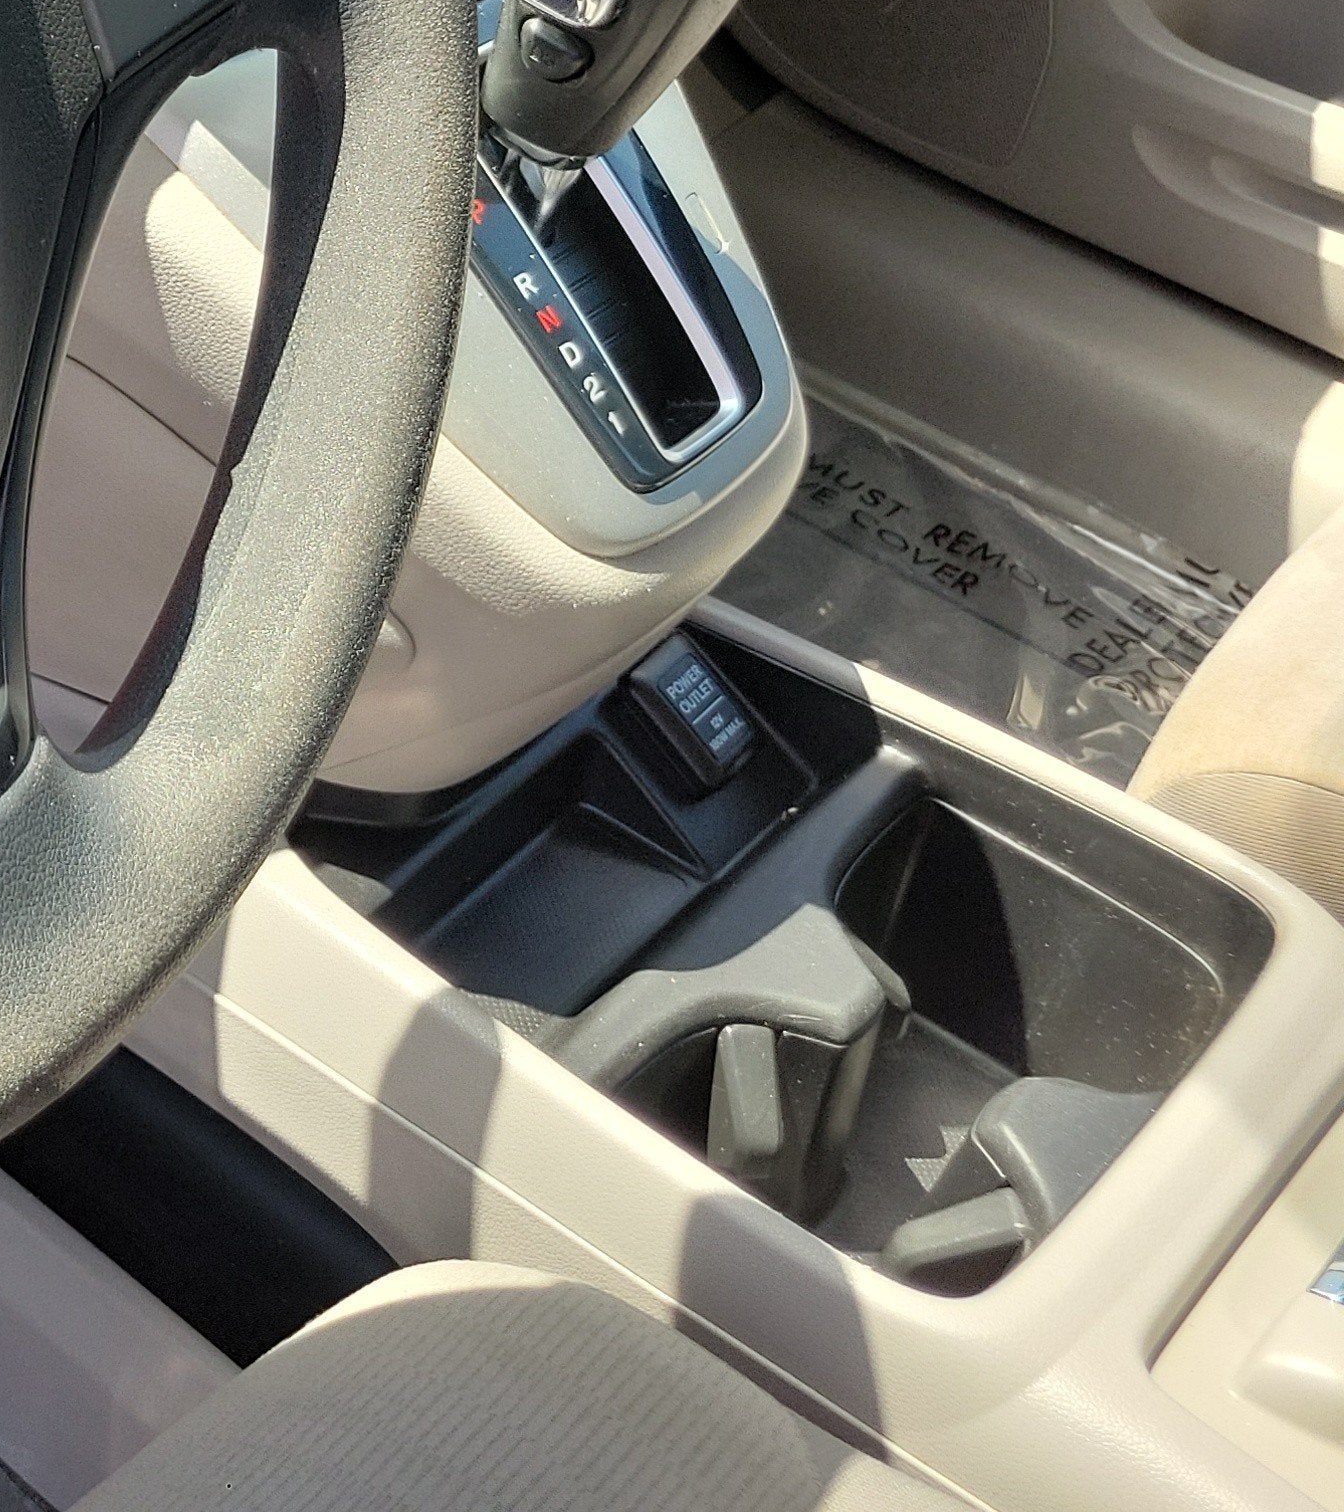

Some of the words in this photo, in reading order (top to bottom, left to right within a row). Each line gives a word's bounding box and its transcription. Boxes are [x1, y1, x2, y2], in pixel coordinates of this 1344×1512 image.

[513, 272, 539, 299] R
[536, 305, 562, 334] N
[558, 342, 581, 370] D
[583, 375, 607, 403] 2
[608, 410, 625, 435] 1
[851, 508, 979, 595] COVER
[923, 522, 1095, 629] REMOVE
[666, 664, 704, 700] POWER
[679, 678, 714, 713] OUTLET
